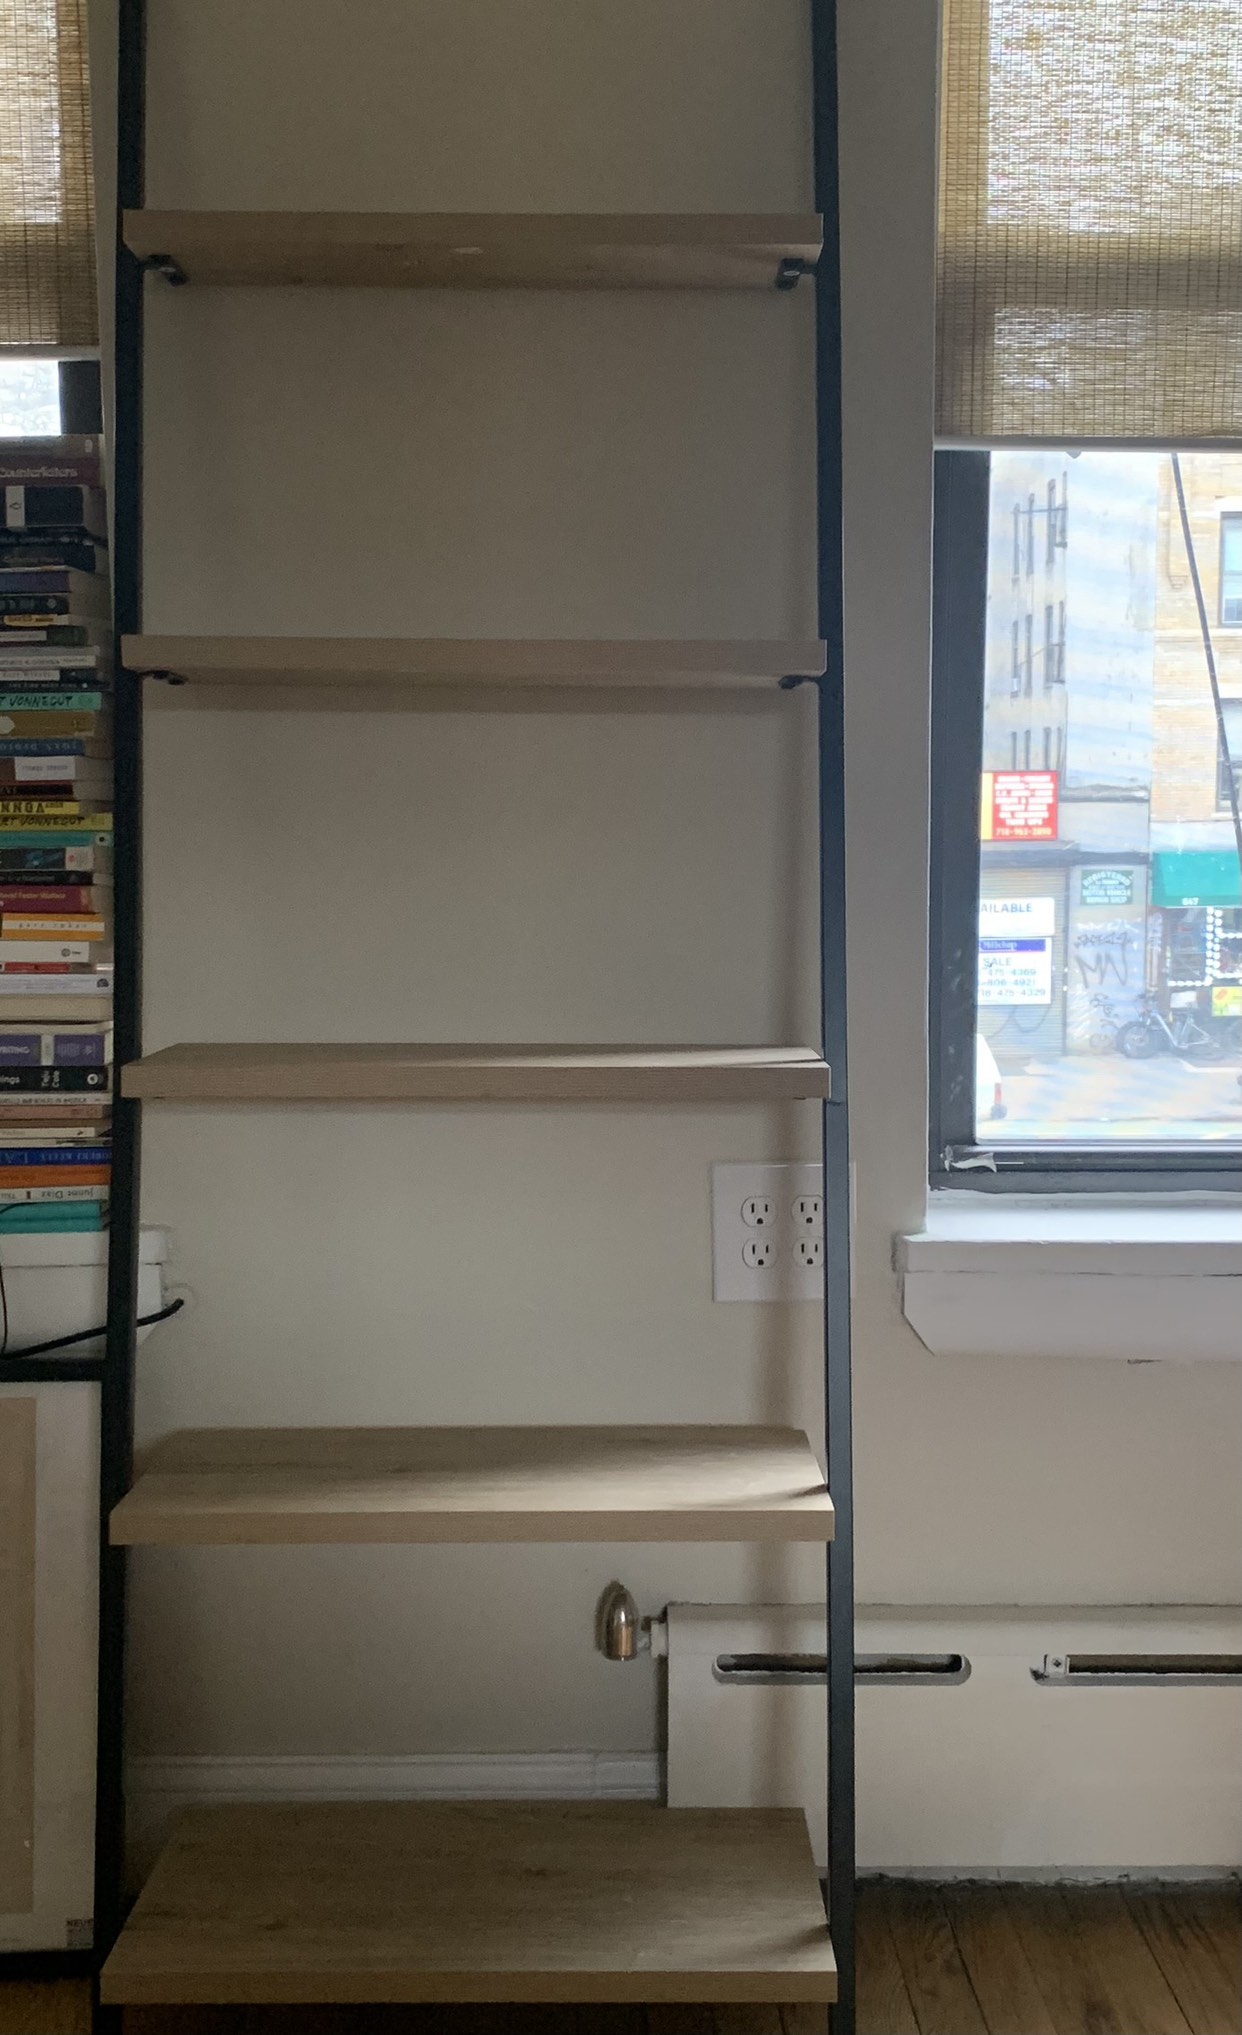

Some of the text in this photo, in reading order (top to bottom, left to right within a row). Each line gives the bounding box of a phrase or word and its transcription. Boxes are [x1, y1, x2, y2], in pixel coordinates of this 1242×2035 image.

[9, 695, 73, 707] VONNEGUT
[19, 816, 85, 826] VONNEGUT
[983, 957, 1012, 968] SALE
